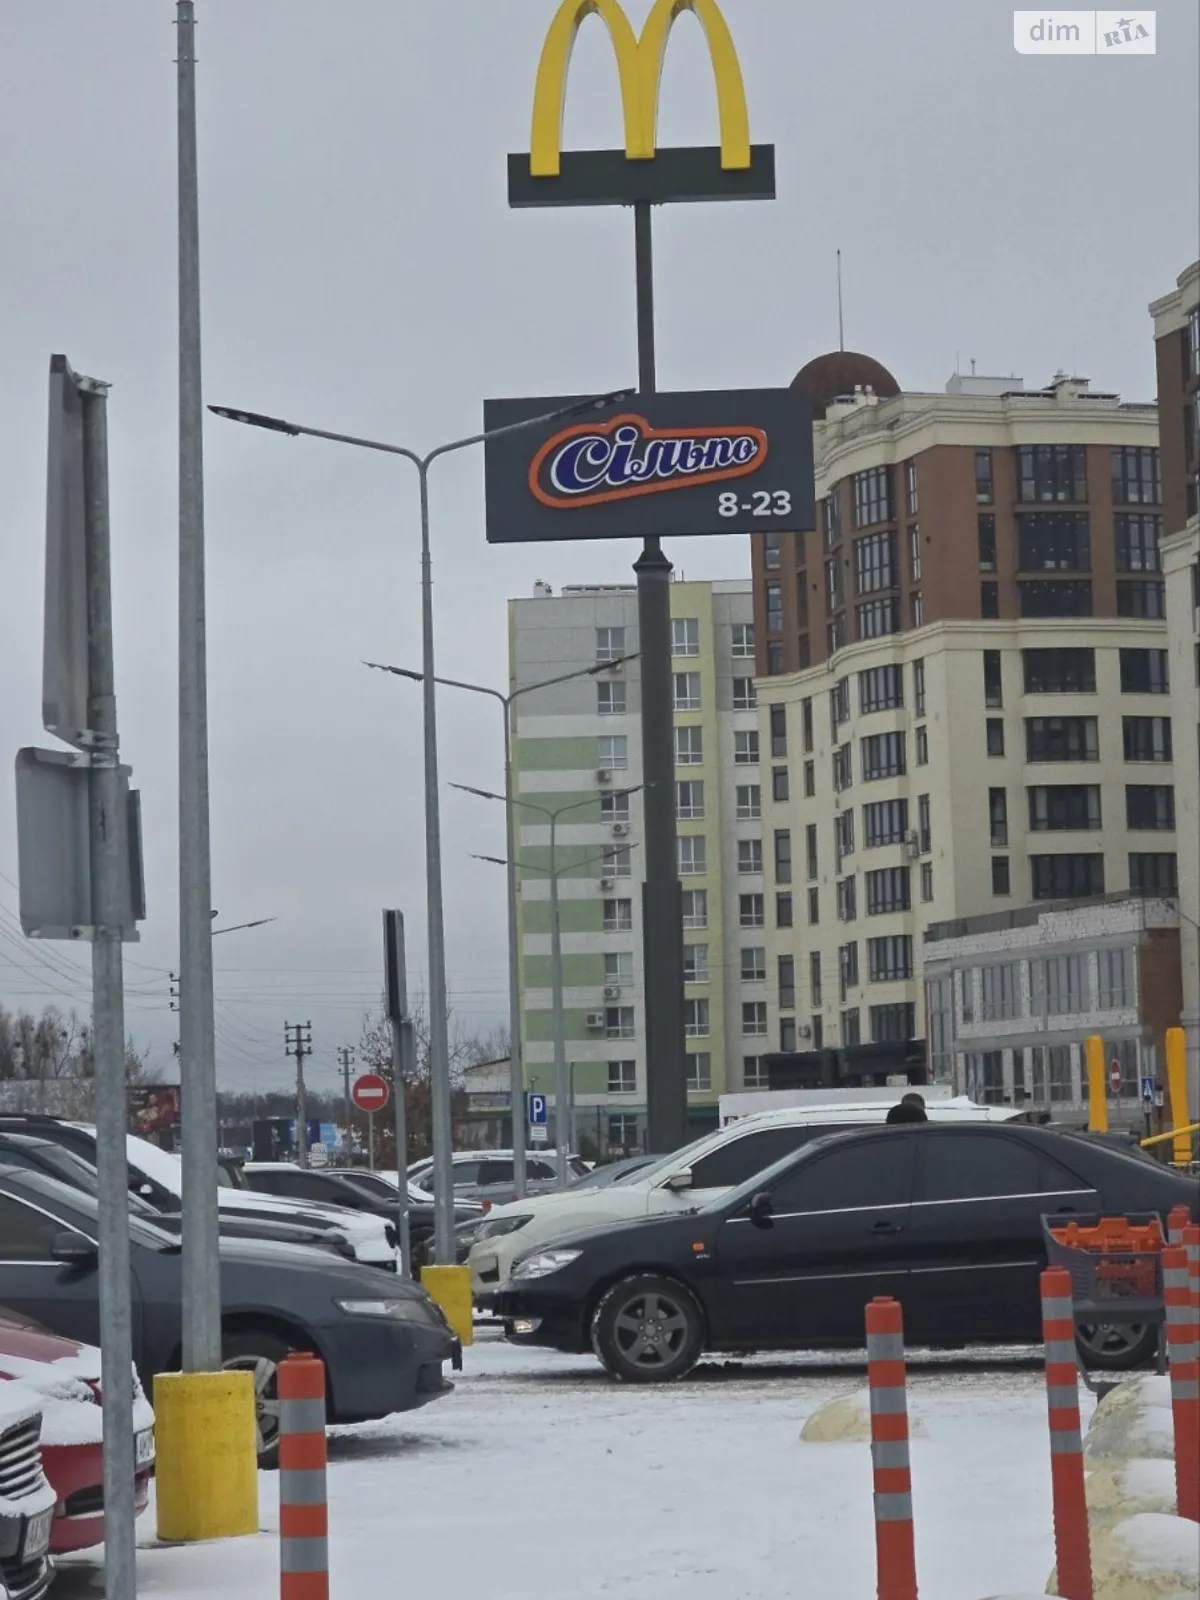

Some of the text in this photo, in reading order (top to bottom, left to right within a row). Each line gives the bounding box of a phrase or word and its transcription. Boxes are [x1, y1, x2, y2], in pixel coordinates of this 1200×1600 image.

[550, 425, 758, 494] Сільпо
[717, 489, 792, 518] 8-23
[532, 1096, 543, 1122] P
